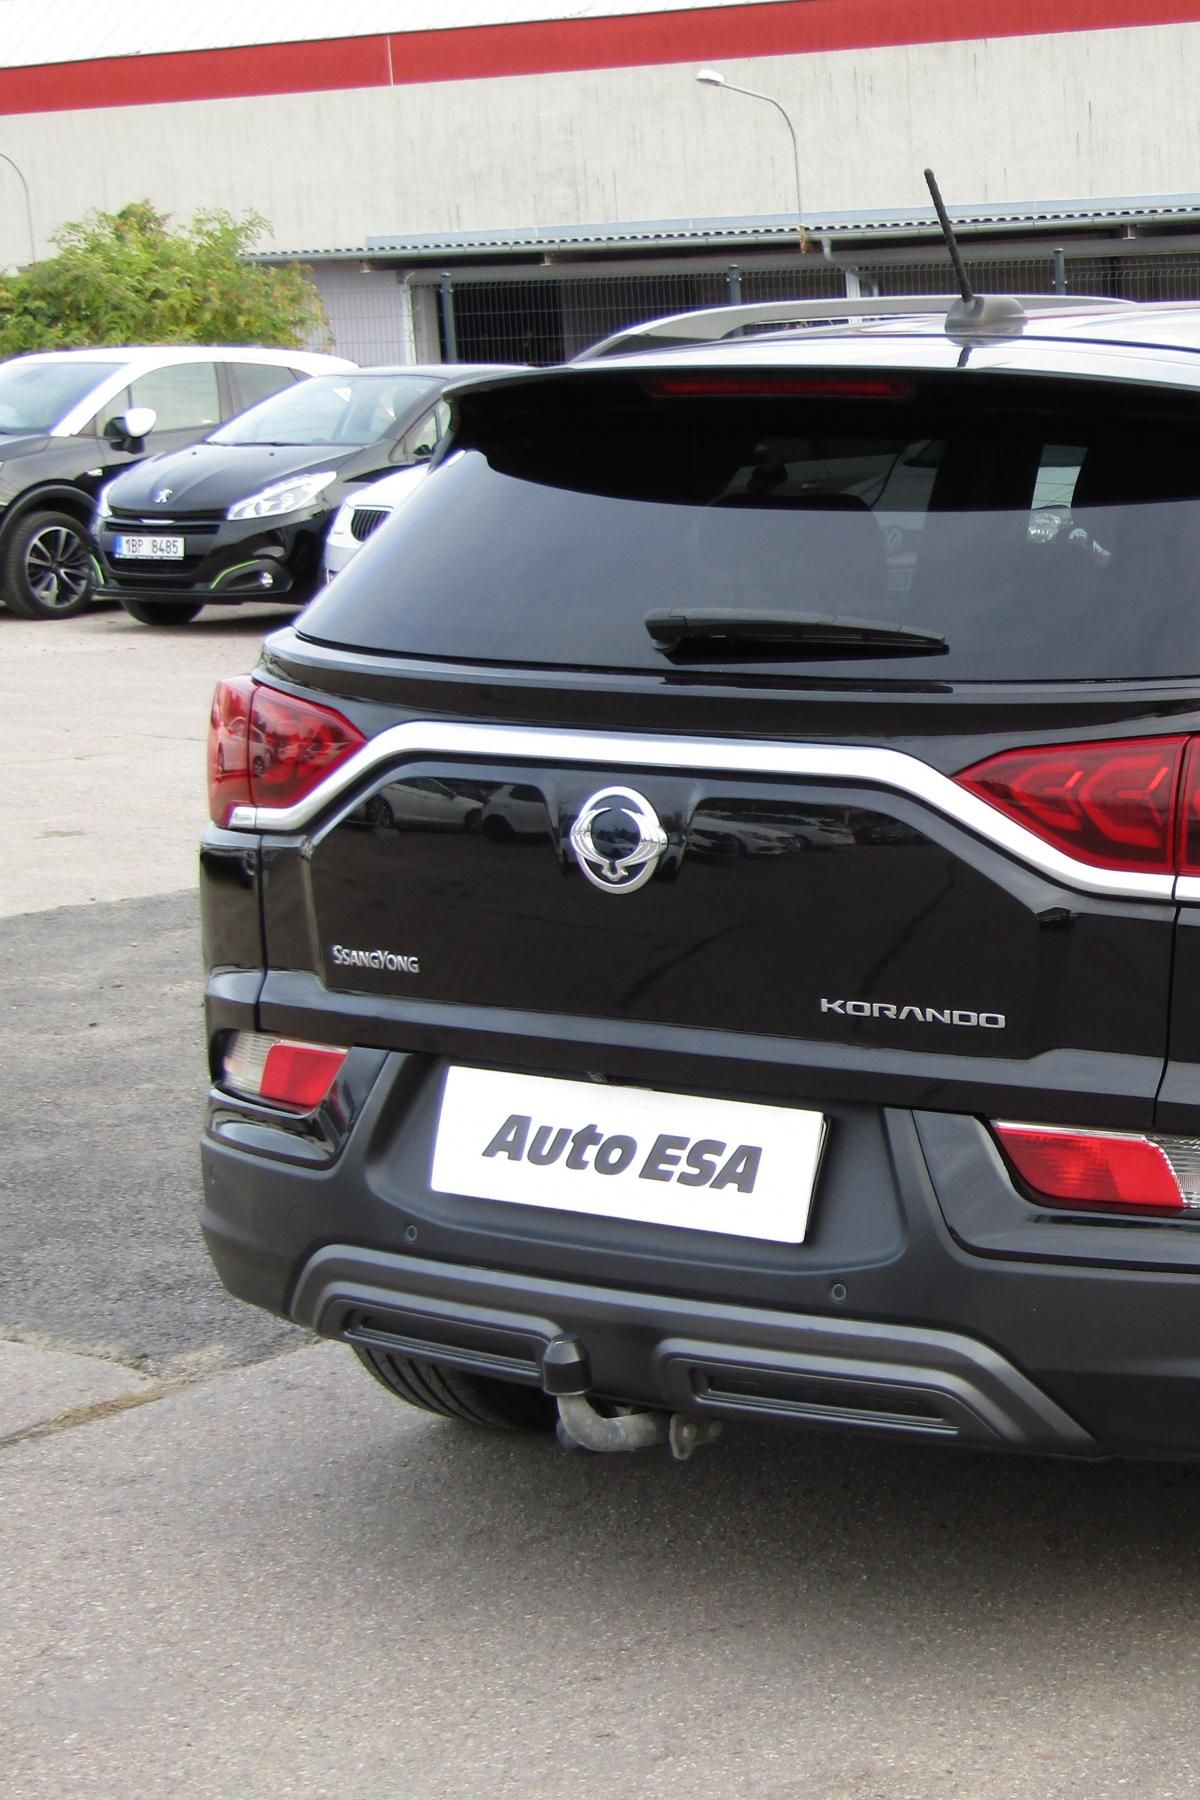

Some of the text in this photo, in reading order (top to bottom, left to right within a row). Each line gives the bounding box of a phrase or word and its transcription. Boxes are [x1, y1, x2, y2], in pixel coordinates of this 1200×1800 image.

[125, 539, 179, 554] 1BP 8485
[821, 998, 1006, 1029] KORANDO
[481, 1113, 763, 1194] Auto ESA
